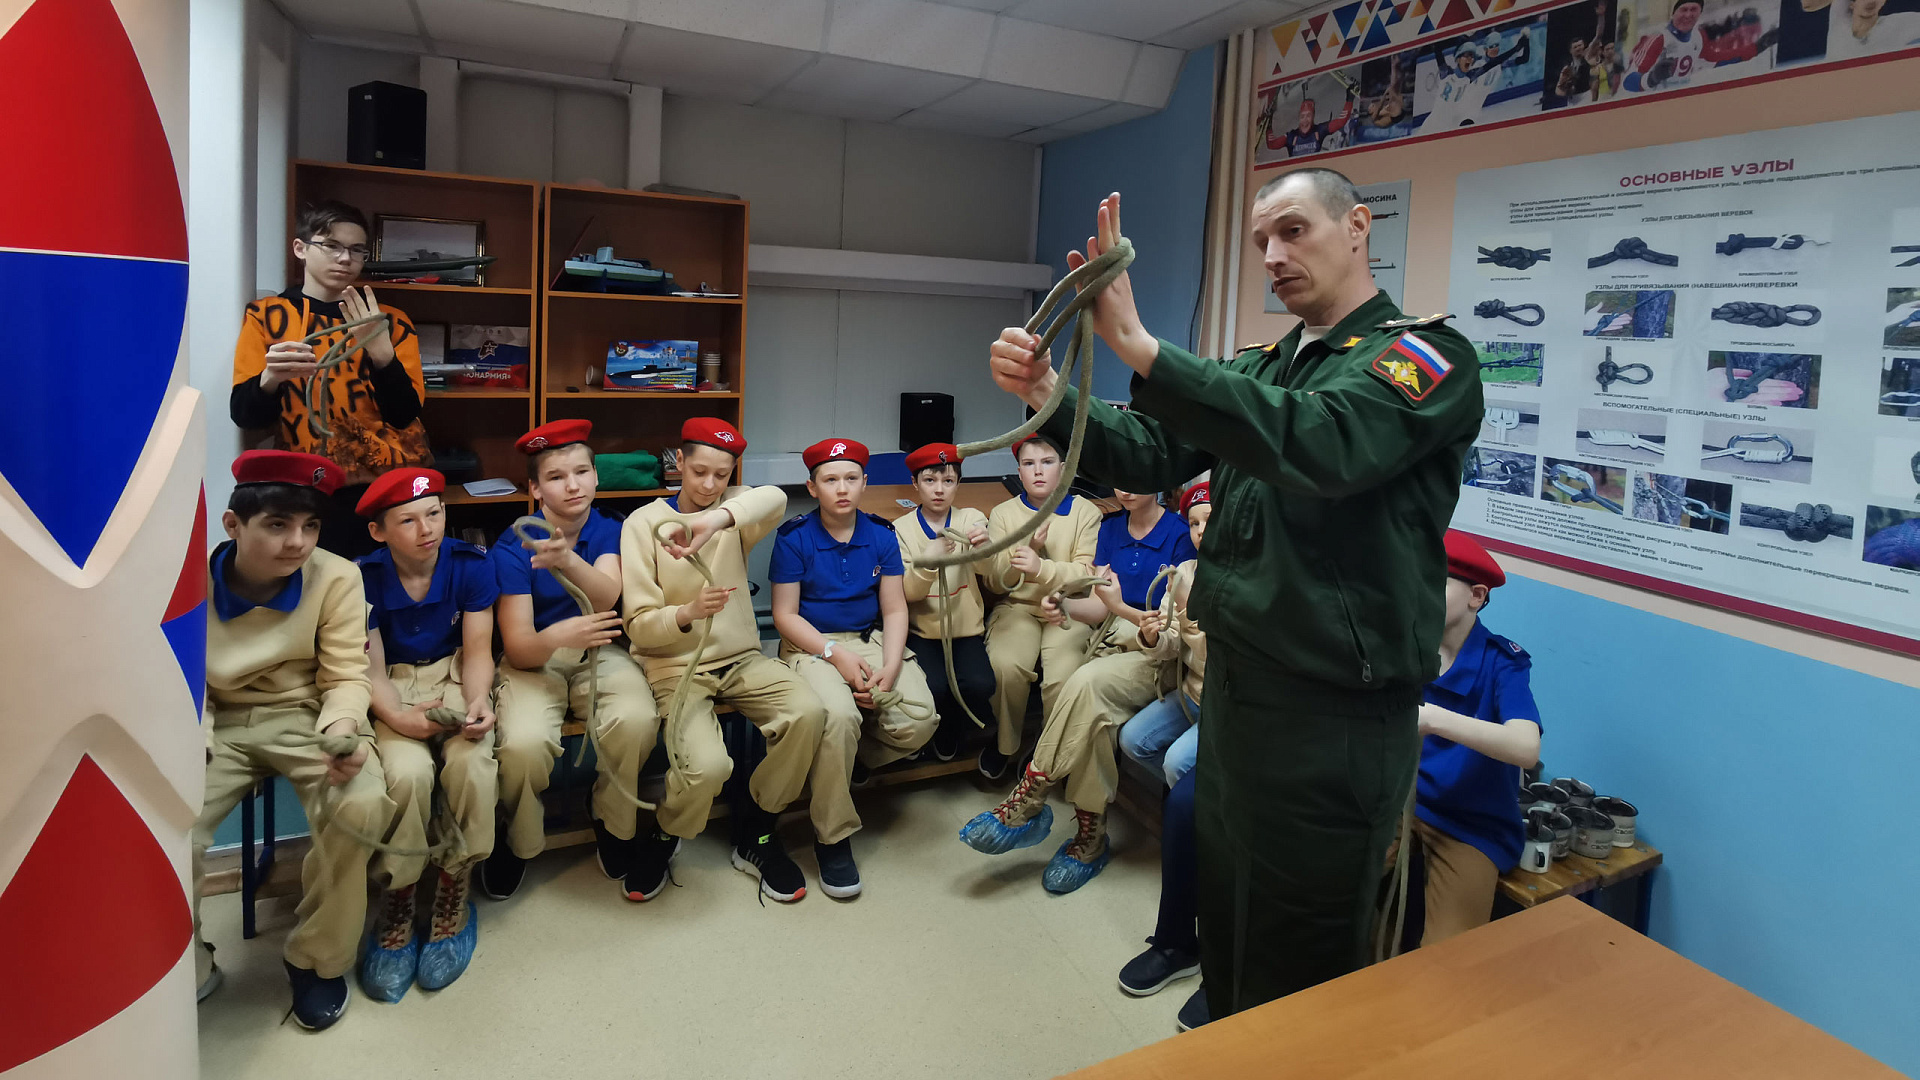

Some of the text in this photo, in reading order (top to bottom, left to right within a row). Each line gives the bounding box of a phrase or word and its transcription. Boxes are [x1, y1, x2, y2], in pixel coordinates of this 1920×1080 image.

[1620, 158, 1794, 188] ОСНОВНЫЕ УЗЛЫ
[1602, 401, 1766, 422] ВСПОМОГАТЕЛЬНЫЕ (СПЕЦИАЛЬНЫЕ) УЗЛЫ
